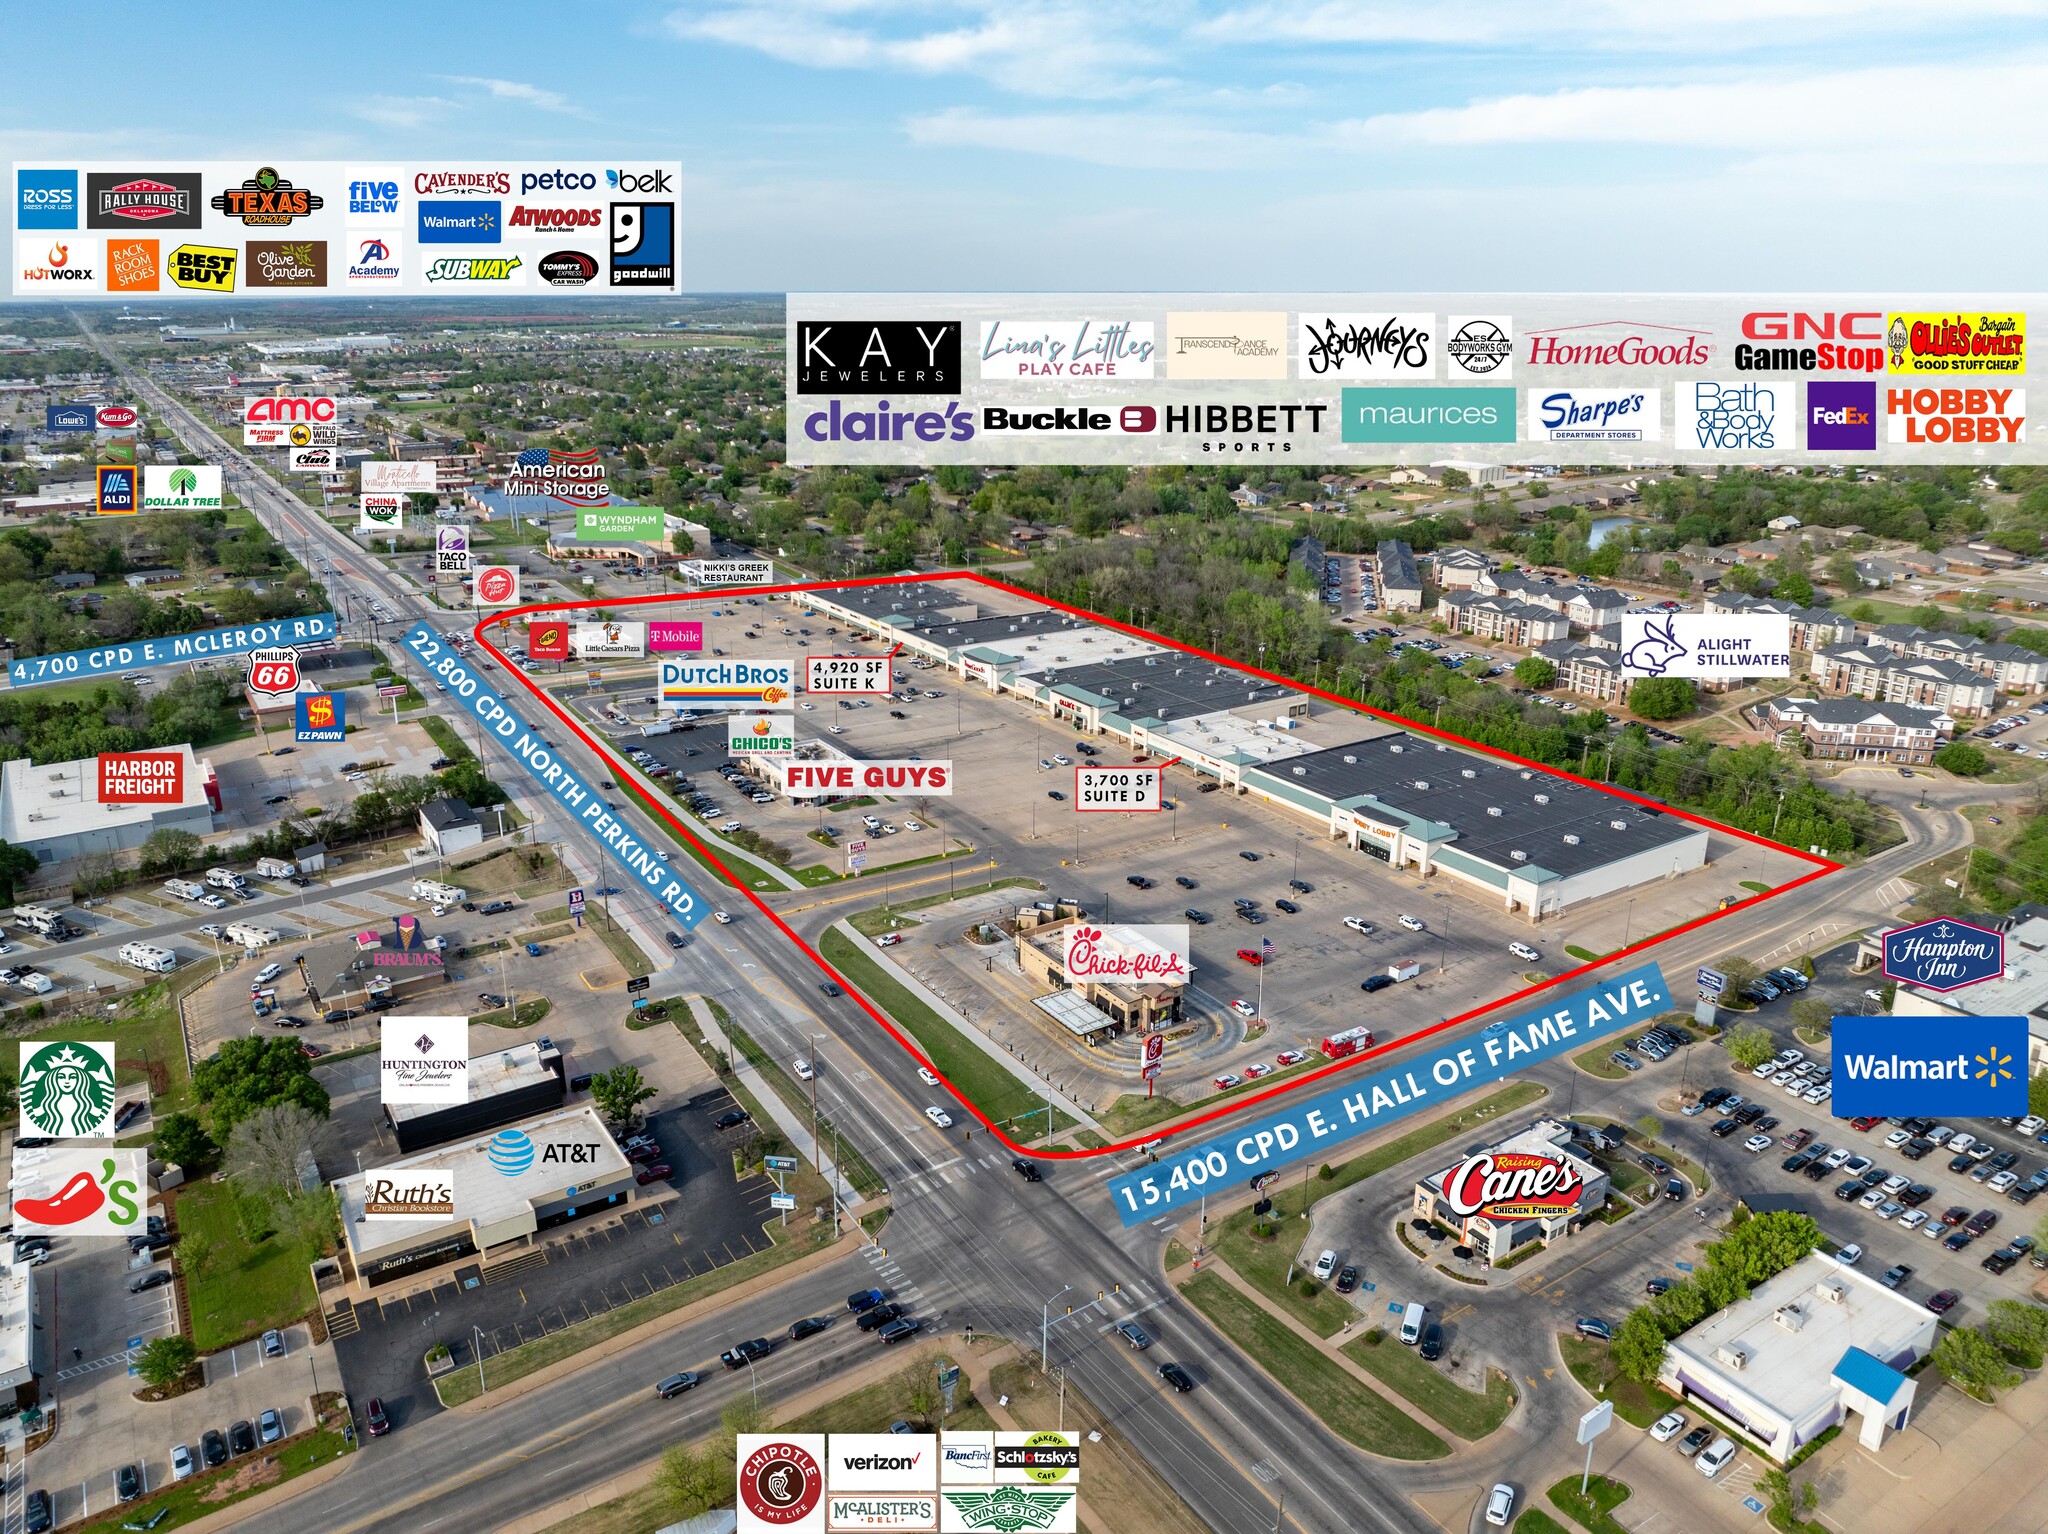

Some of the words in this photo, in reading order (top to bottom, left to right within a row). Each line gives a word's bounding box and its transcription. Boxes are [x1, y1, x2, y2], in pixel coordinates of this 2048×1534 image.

[1372, 827, 1396, 839] LOBBY
[577, 1180, 597, 1193] AT&T
[381, 1255, 413, 1271] Ruth's
